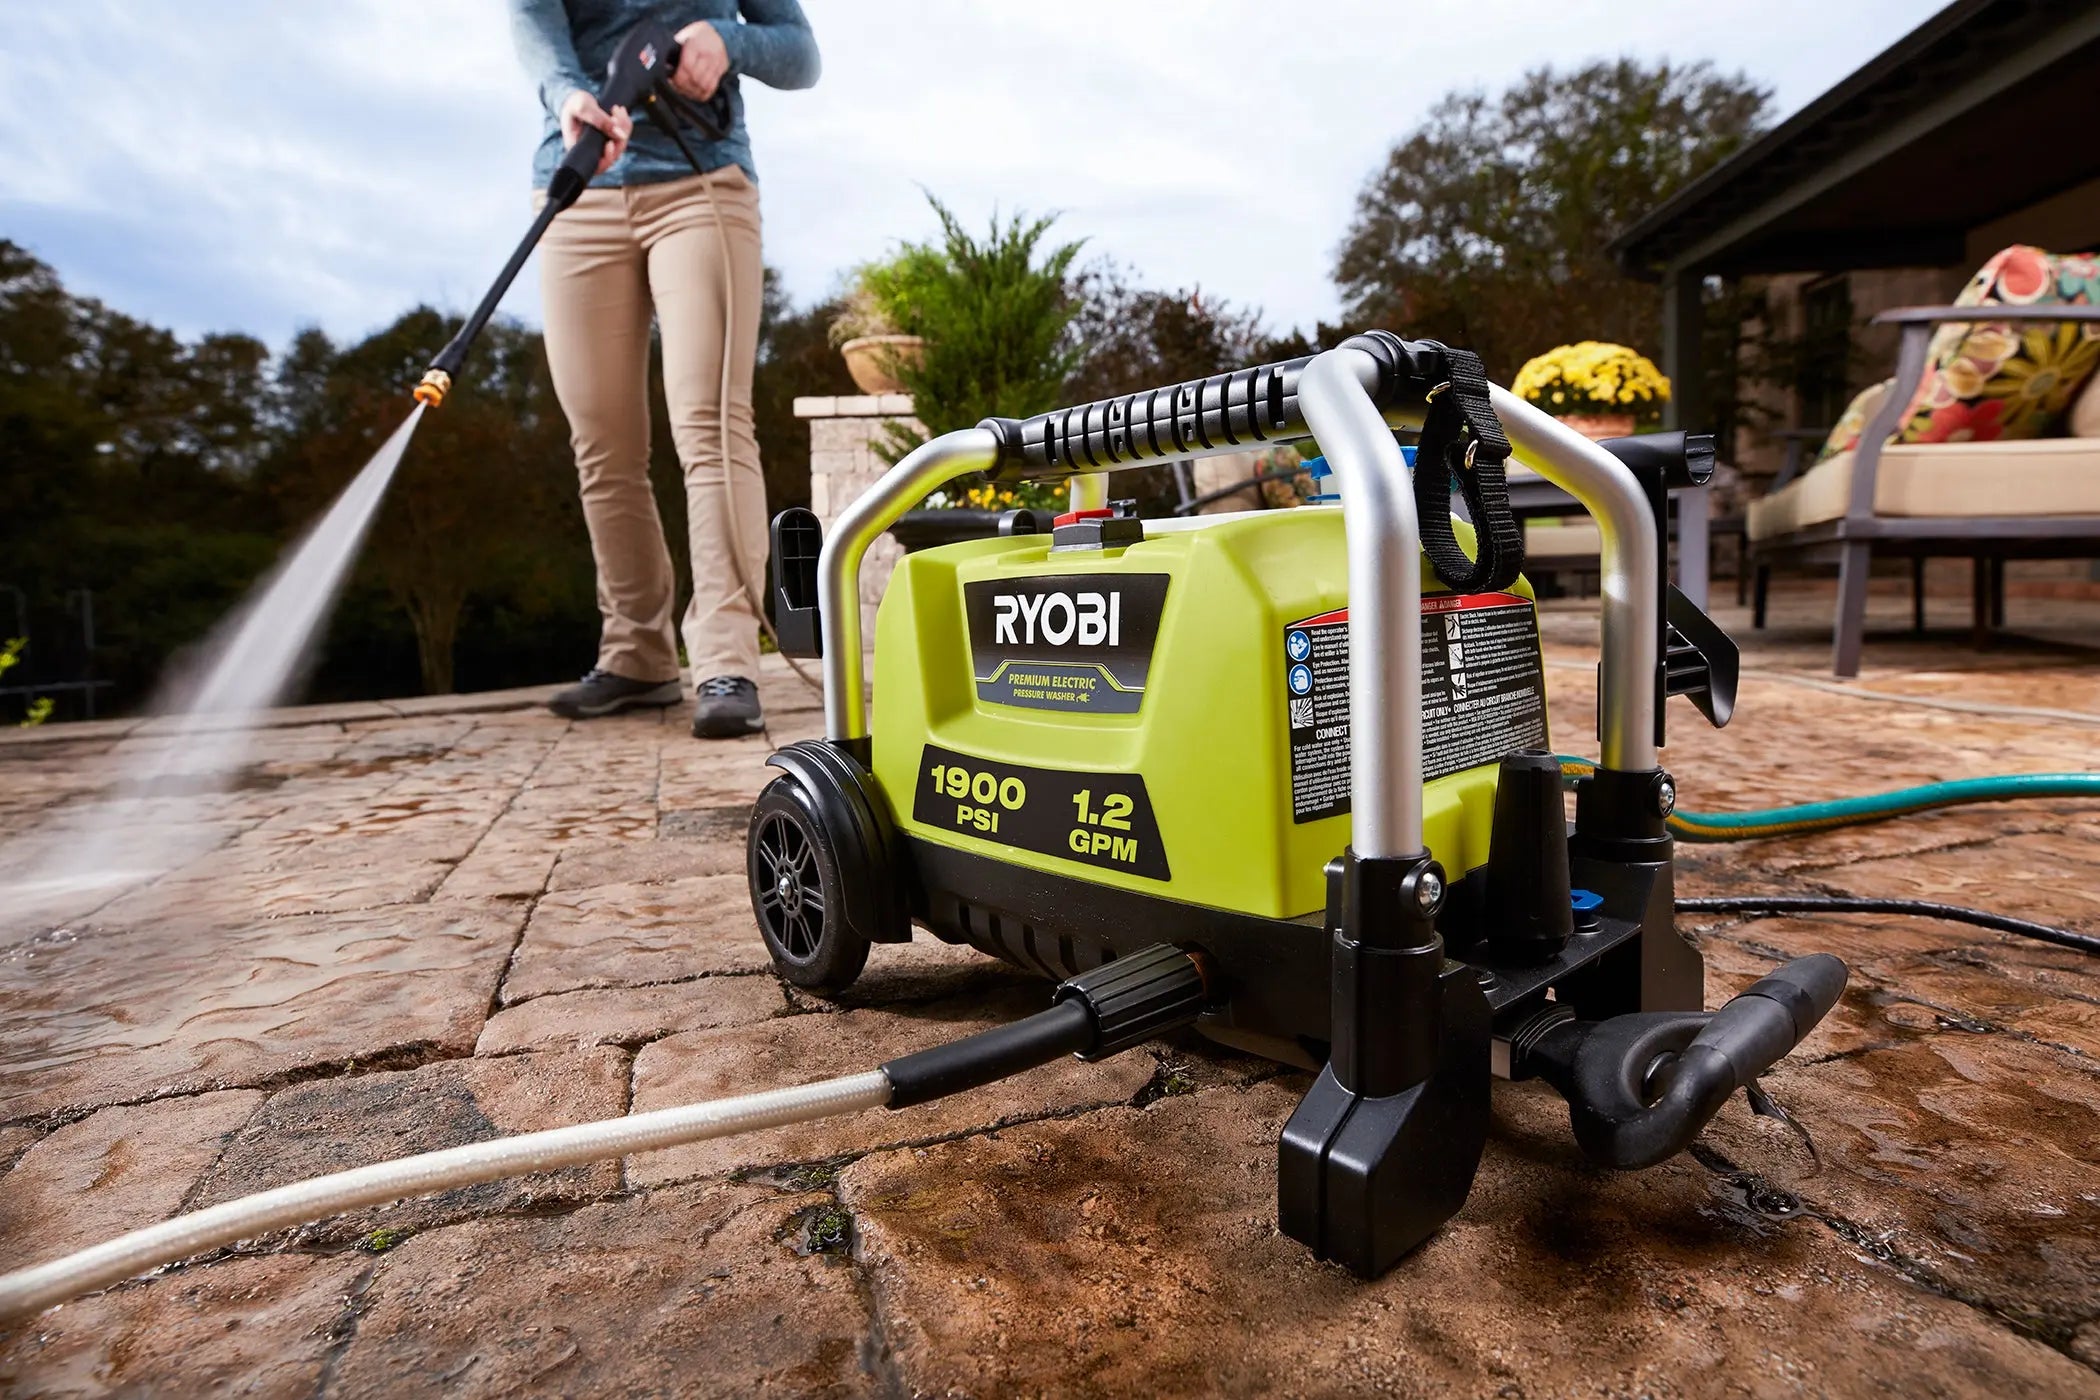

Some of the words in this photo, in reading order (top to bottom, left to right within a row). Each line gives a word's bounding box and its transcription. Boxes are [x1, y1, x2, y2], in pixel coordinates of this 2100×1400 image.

[1422, 601, 1438, 610] ANGER
[1444, 600, 1462, 608] DANGER
[994, 592, 1120, 646] RYOBI
[1008, 673, 1050, 686] PREMIUM
[1052, 676, 1096, 690] ELECTRIC
[1013, 689, 1045, 699] PRESSURE
[1046, 691, 1075, 701] WASHER
[1422, 708, 1436, 720] RCUIT
[1436, 706, 1449, 717] ONLY
[1453, 700, 1480, 713] CONNECTER
[1486, 694, 1500, 706] CIRCUIT
[1316, 724, 1348, 740] CONNECT
[931, 764, 1026, 811] 1900
[957, 805, 999, 833] PSI
[1072, 790, 1134, 831] 1.2
[1068, 829, 1138, 863] GPM
